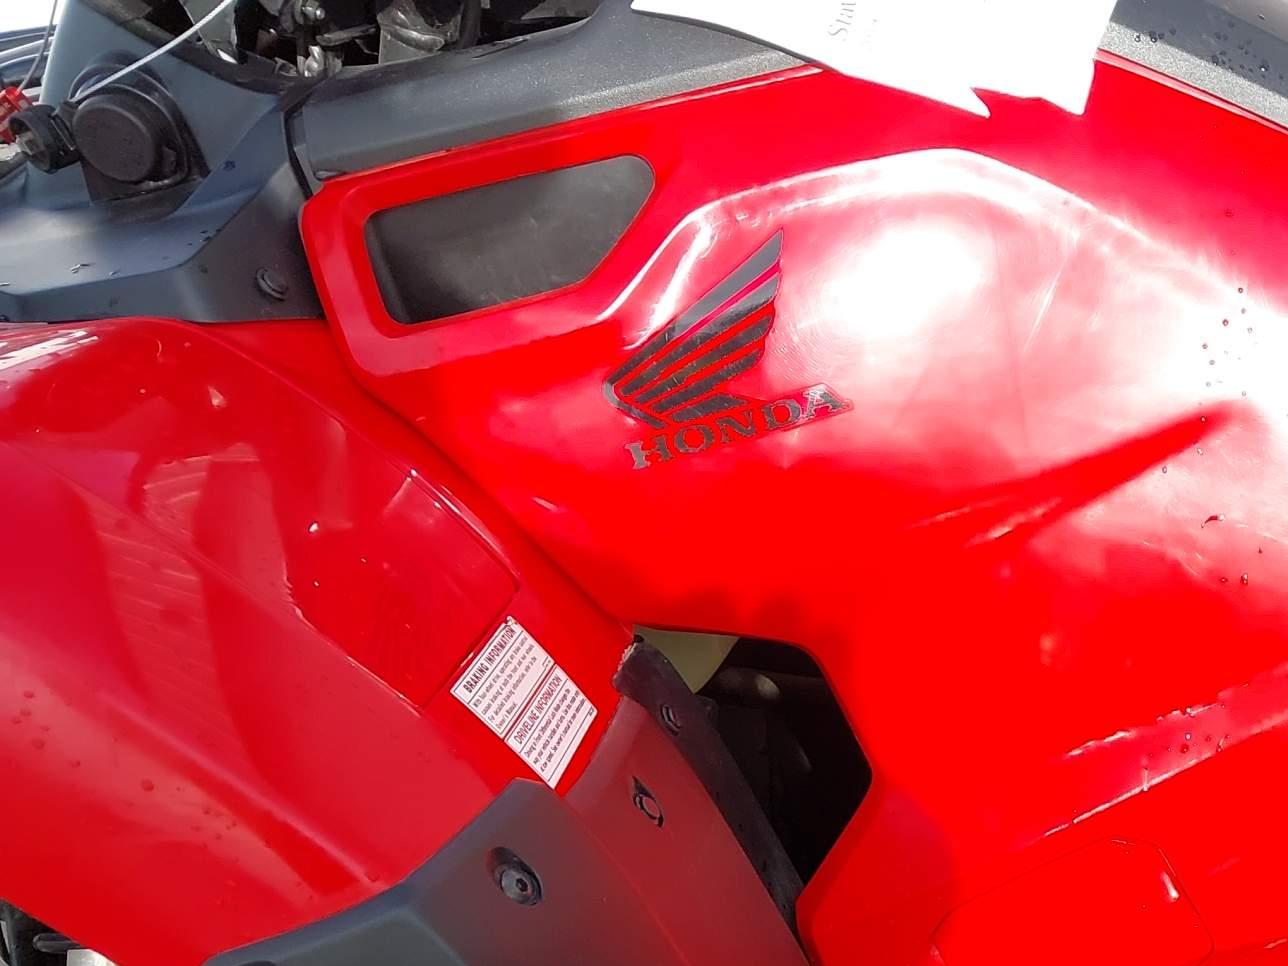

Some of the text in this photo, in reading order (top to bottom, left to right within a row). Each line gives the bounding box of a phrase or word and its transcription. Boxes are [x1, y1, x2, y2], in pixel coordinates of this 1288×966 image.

[625, 386, 847, 470] HONDA
[461, 625, 518, 694] BRAKING INFORMATION
[512, 673, 563, 745] DRIVELINE INFORMATION
